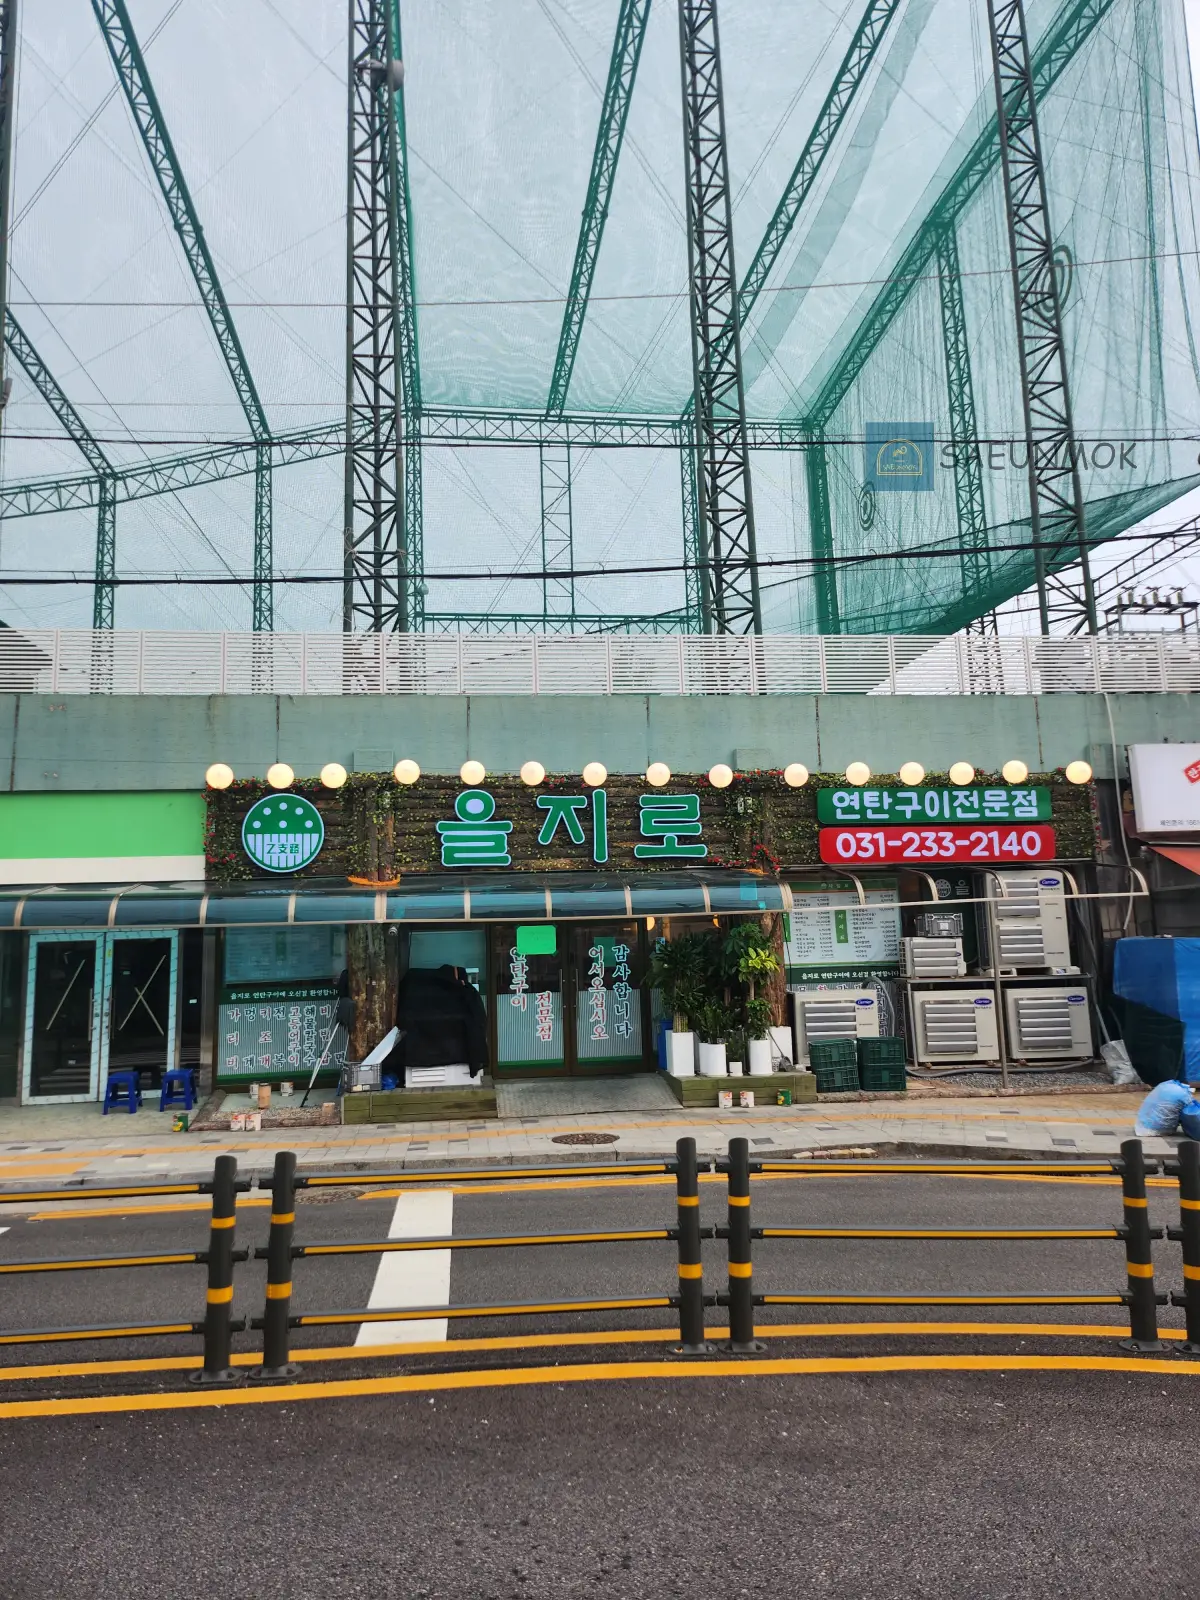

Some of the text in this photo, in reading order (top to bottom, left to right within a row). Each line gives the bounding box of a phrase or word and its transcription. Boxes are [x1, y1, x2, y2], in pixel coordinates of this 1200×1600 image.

[436, 789, 708, 867] 을지로
[832, 789, 1039, 820] 연탄구이전문점
[835, 830, 1042, 858] 031-233-2140
[535, 990, 554, 1042] 전문점
[588, 945, 610, 1041] 어서오십시오
[612, 944, 633, 1039] 감사합니다
[287, 1005, 303, 1066] 고등어구이
[302, 1005, 317, 1067] 해물칼국수
